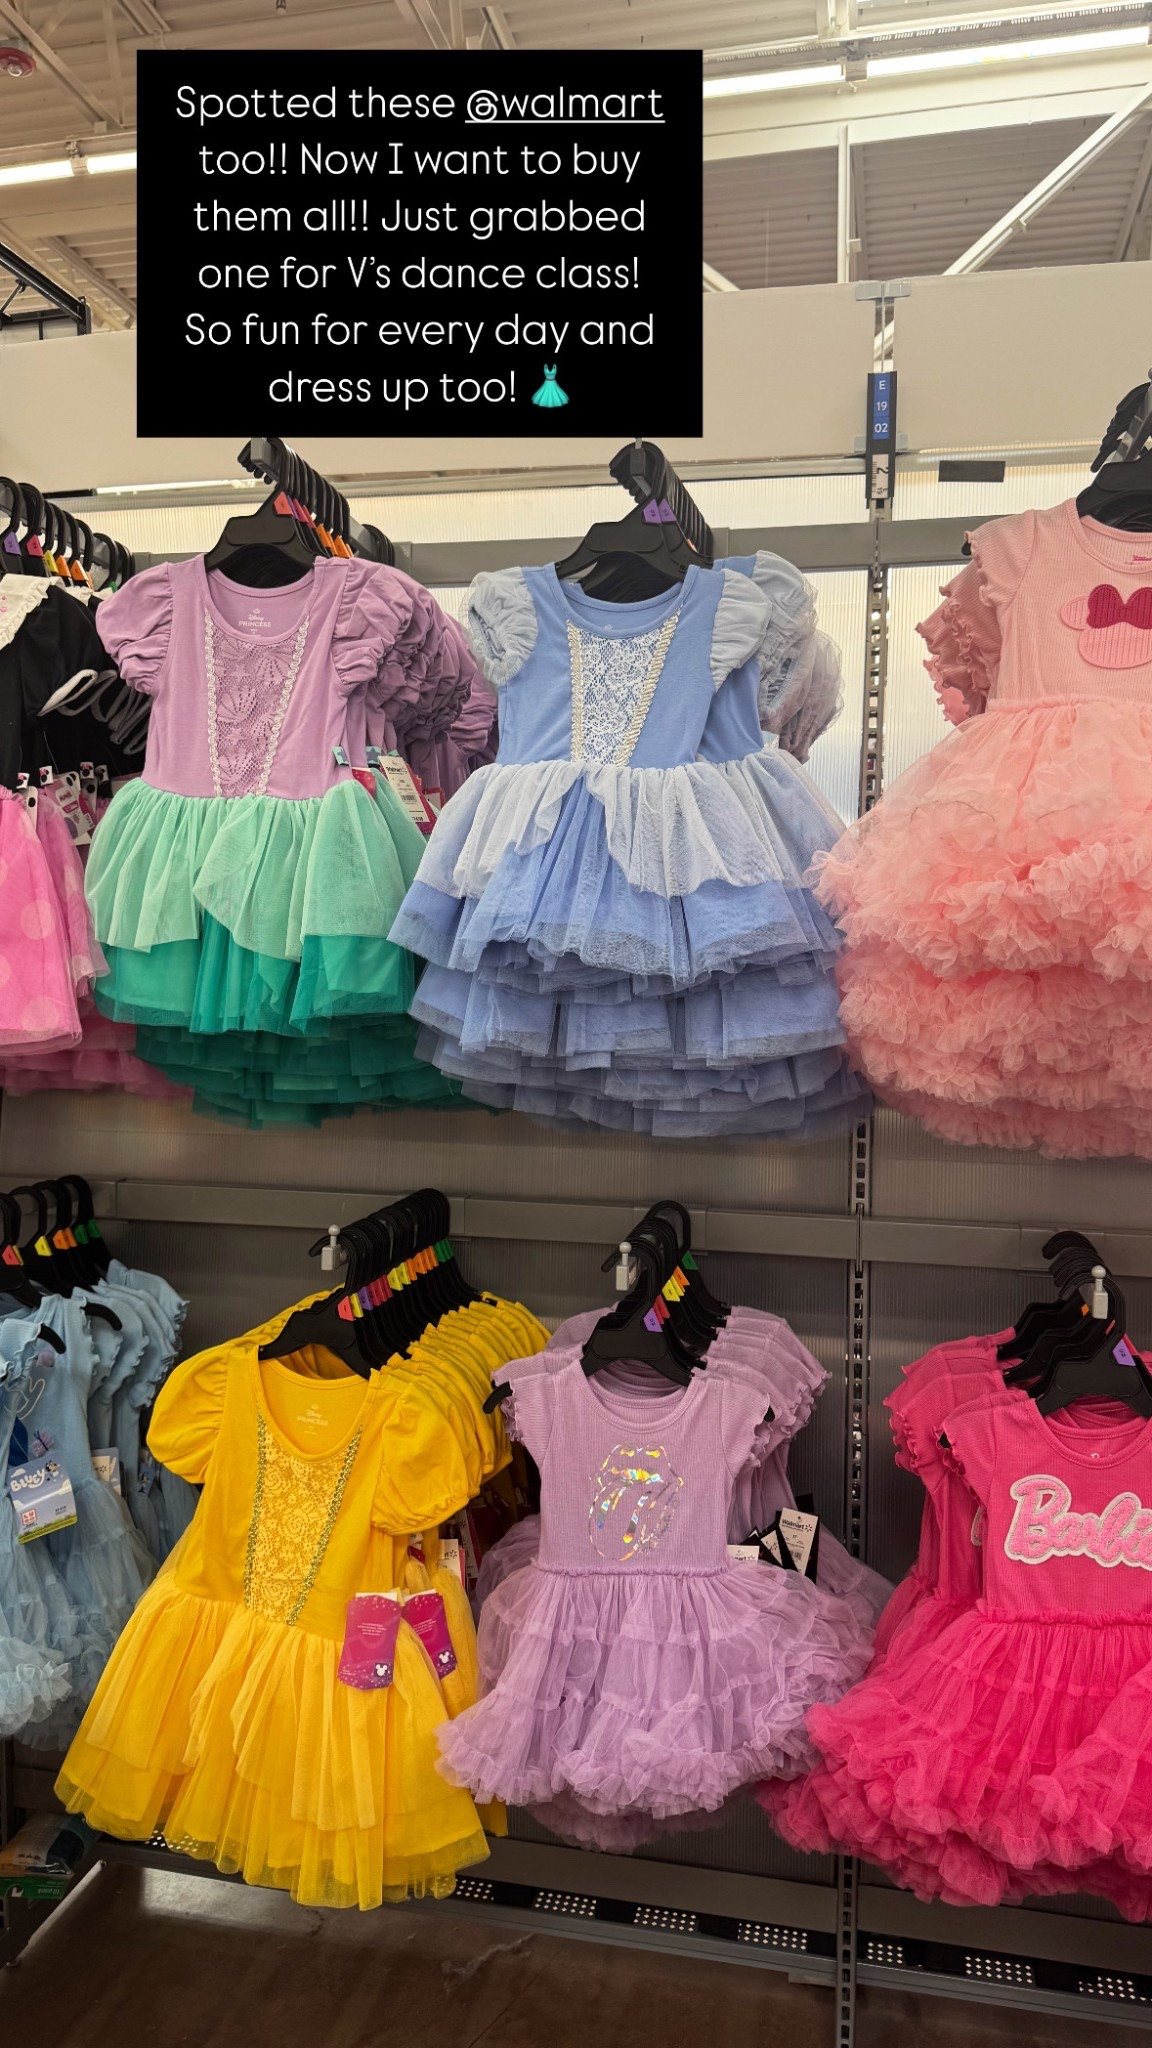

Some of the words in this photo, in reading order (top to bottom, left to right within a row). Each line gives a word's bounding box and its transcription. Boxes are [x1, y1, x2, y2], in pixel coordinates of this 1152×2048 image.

[879, 380, 886, 390] E
[876, 401, 888, 411] 19
[874, 423, 888, 433] 02
[781, 1518, 804, 1530] Walmart
